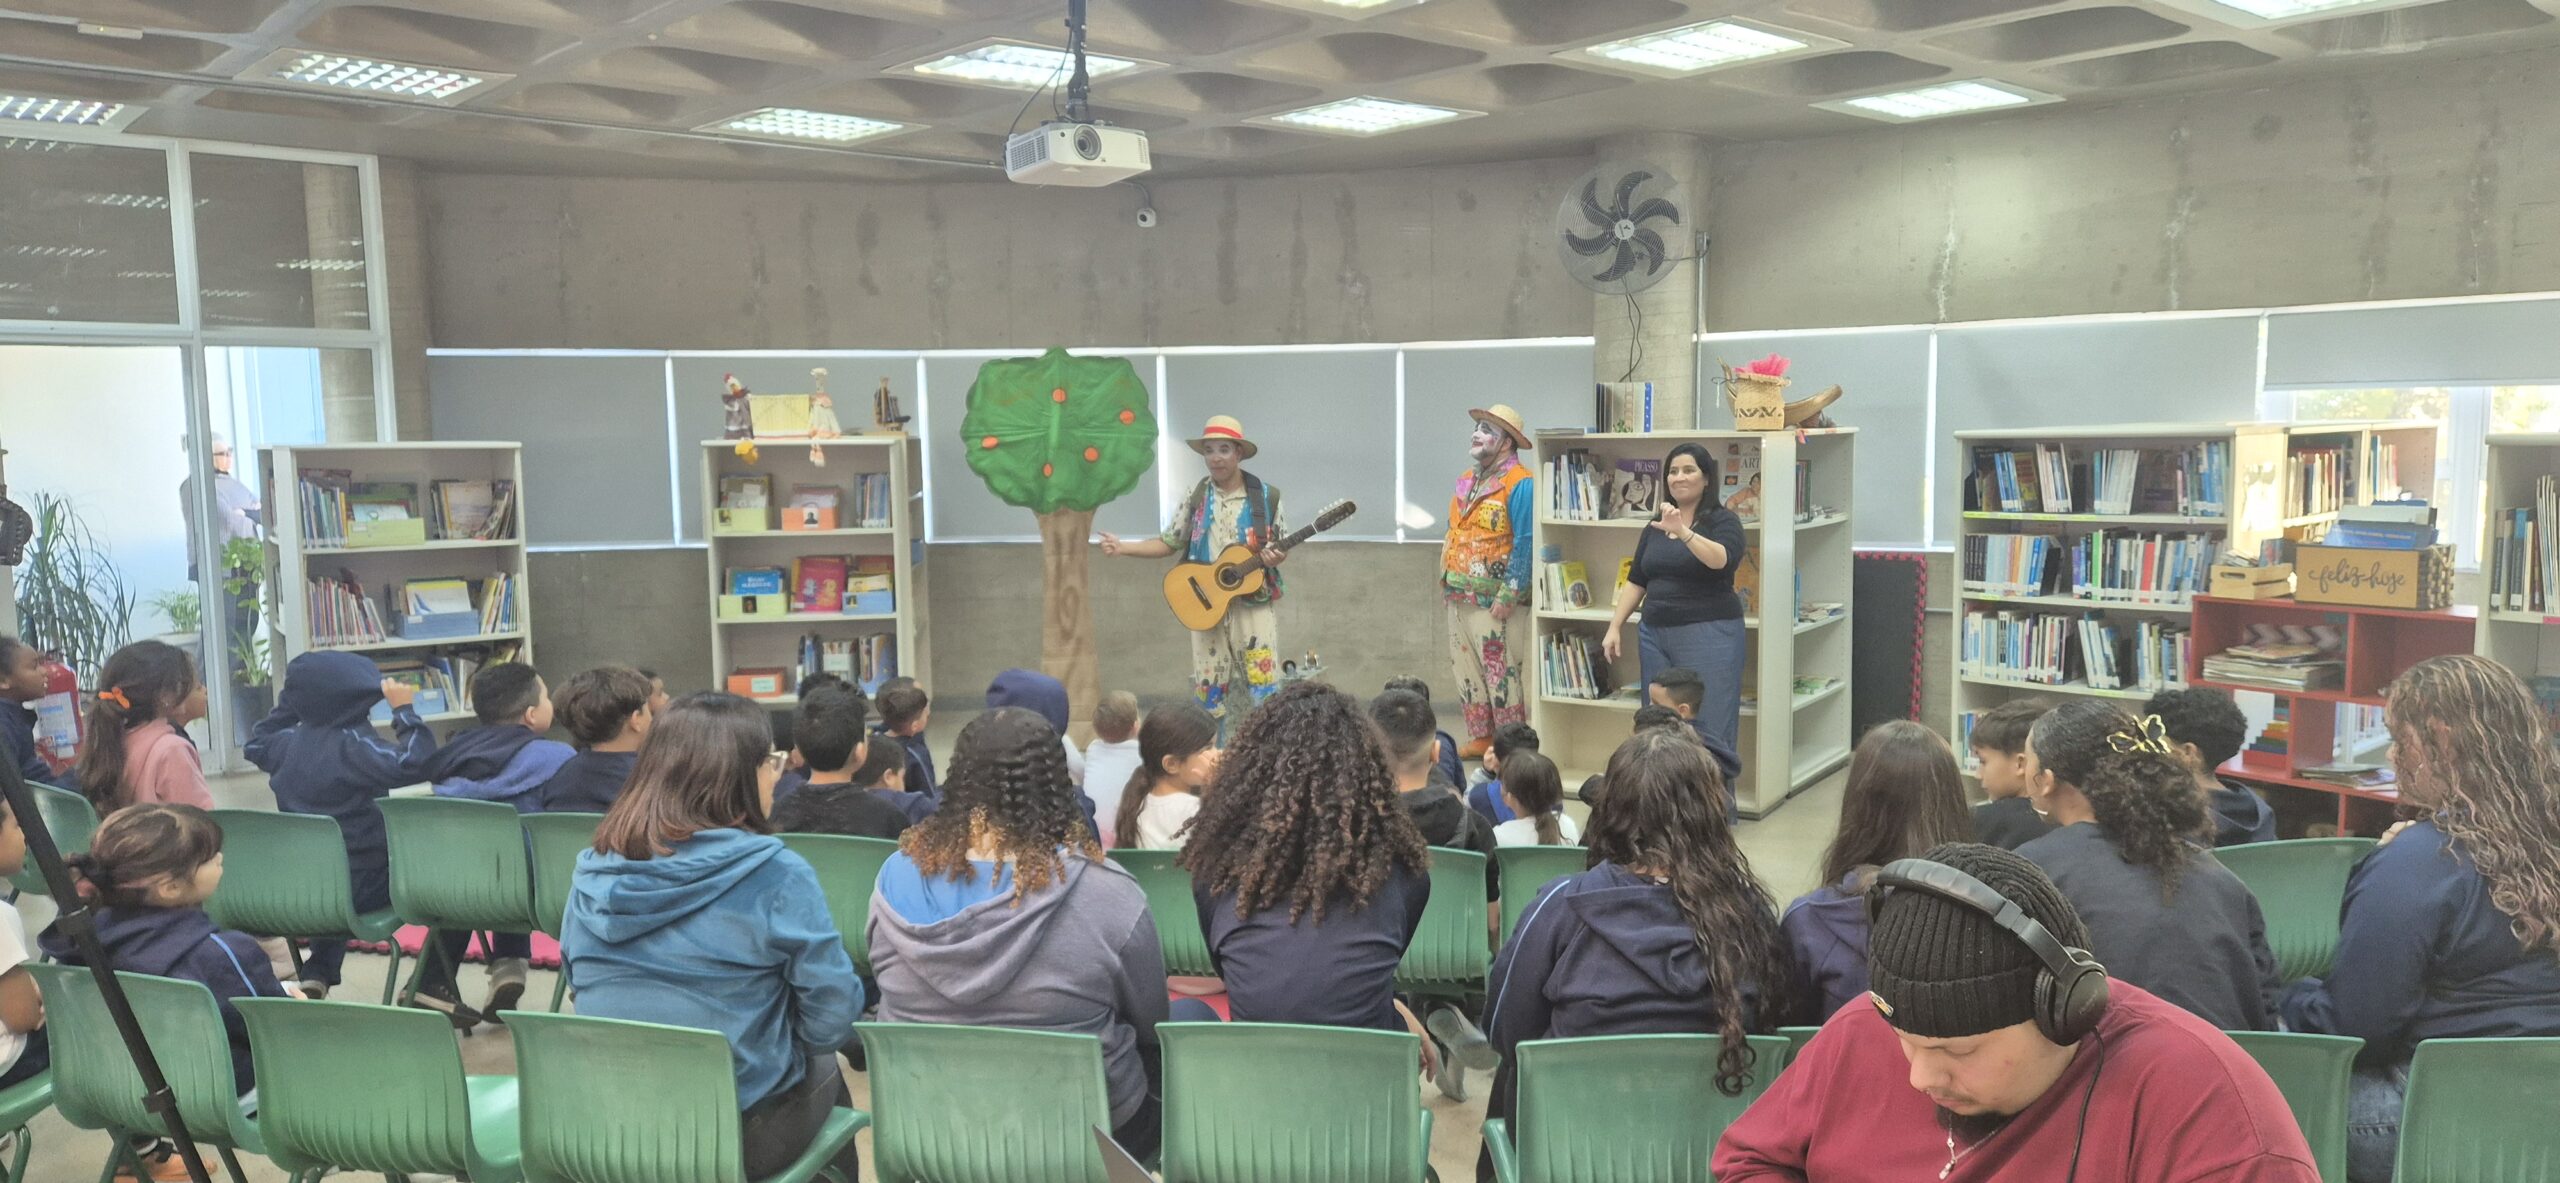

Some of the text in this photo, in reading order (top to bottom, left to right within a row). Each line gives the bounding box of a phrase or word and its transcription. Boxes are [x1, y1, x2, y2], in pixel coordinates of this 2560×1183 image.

[1634, 461, 1658, 473] PICASSO
[2308, 558, 2405, 594] feliz hoje
